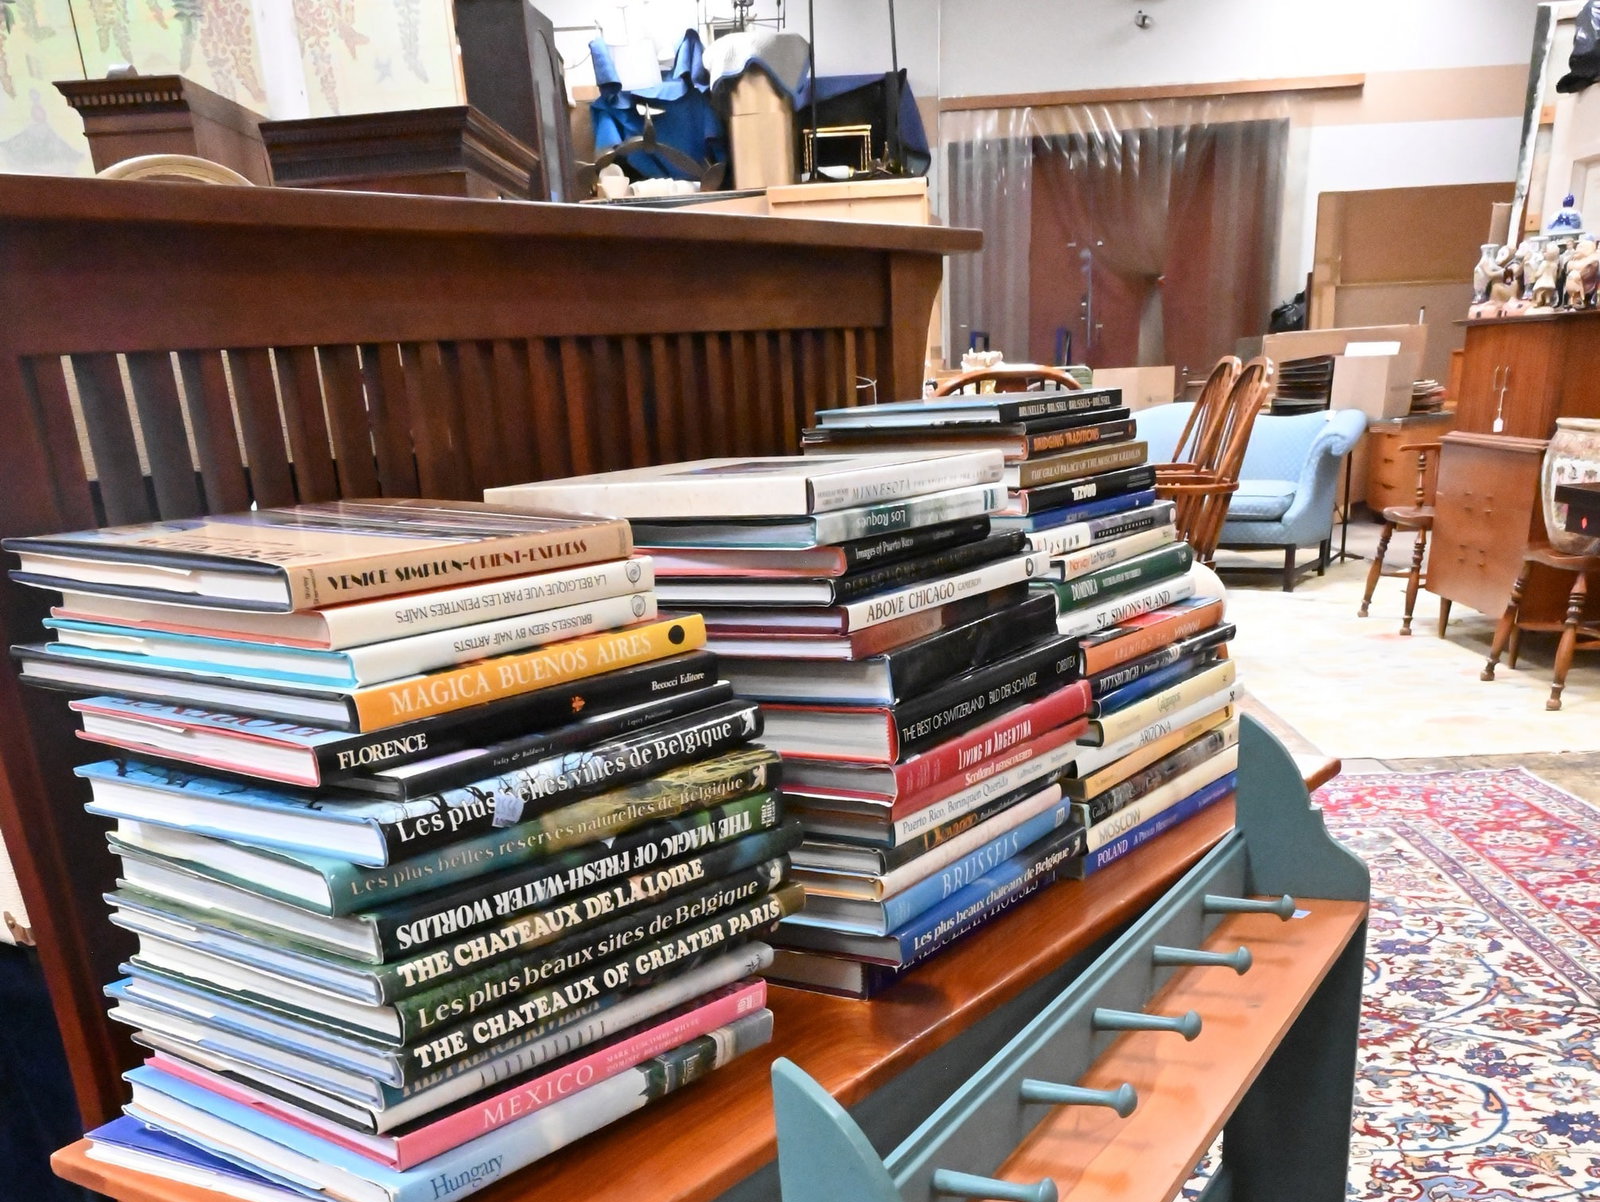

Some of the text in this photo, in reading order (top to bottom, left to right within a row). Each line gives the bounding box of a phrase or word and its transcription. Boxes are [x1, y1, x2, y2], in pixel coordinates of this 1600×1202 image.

[1066, 428, 1099, 445] TRADITIONS
[852, 479, 910, 500] MINNESOTA
[856, 509, 906, 527] Los Roques
[327, 538, 588, 591] VENICE SIMPLON-ORIENT-EXPRESS
[855, 537, 914, 560] Images of Puerto Rico
[395, 573, 607, 623] LA BELGIQUE VUE PAR LES PEINTRES NAÏFS
[867, 596, 904, 623] ABOVE
[909, 582, 954, 610] CHICAGO
[1072, 578, 1098, 601] DOMINICA
[526, 620, 551, 637] SEEN
[552, 612, 593, 630] BRUSSELS
[1097, 612, 1109, 629] ST.
[1142, 591, 1170, 612] ISLAND
[454, 634, 490, 652] ARTISTS
[514, 624, 527, 638] BY
[387, 632, 652, 716] MAGICA BUENOS AIRES
[680, 671, 705, 687] Editore
[1100, 665, 1139, 692] PITTSBURGH
[902, 672, 1037, 743] THE BEST OF SWITZERLAND BILD DER SCHWEIZ
[337, 732, 429, 771] FLORENCE
[958, 719, 1031, 770] LIVING IN ARGENTINA
[1139, 721, 1172, 746] ARIZONA
[511, 750, 519, 762] &
[965, 761, 995, 787] Scotland
[396, 719, 732, 842] Les plus belles villes de Belgique
[718, 810, 753, 836] THE
[902, 817, 926, 834] Puerto
[928, 808, 945, 823] Rico,
[983, 775, 1008, 796] Querida
[351, 877, 390, 898] Les
[391, 864, 433, 890] plus
[438, 845, 495, 872] belles
[576, 798, 654, 836] naturelles
[656, 793, 675, 813] de
[679, 775, 744, 809] Belgique
[662, 822, 717, 857] MAGIC
[1098, 807, 1141, 843] MOSCOW
[634, 843, 659, 867] OF
[942, 831, 1019, 899] BRUSSELS
[1097, 839, 1129, 867] POLAND
[495, 850, 632, 916] FRESH-WATER
[914, 931, 932, 950] Les
[933, 918, 955, 941] plus
[956, 900, 985, 923] beaux
[1024, 869, 1035, 881] de
[1035, 847, 1070, 874] Belgique
[395, 900, 494, 950] WORLDS
[397, 858, 705, 988] THE CHATEAUX DE LA LOIRE
[418, 879, 759, 1029] Les plus beaux sites de Belgique
[413, 1033, 469, 1069] THE
[472, 975, 600, 1042] CHATEAUX
[603, 960, 628, 990] OF
[635, 920, 726, 976] GREATER
[728, 900, 781, 935] PARIS
[606, 1050, 630, 1065] MARK
[482, 1063, 595, 1130] MEXICO
[429, 1154, 504, 1201] Hungary
